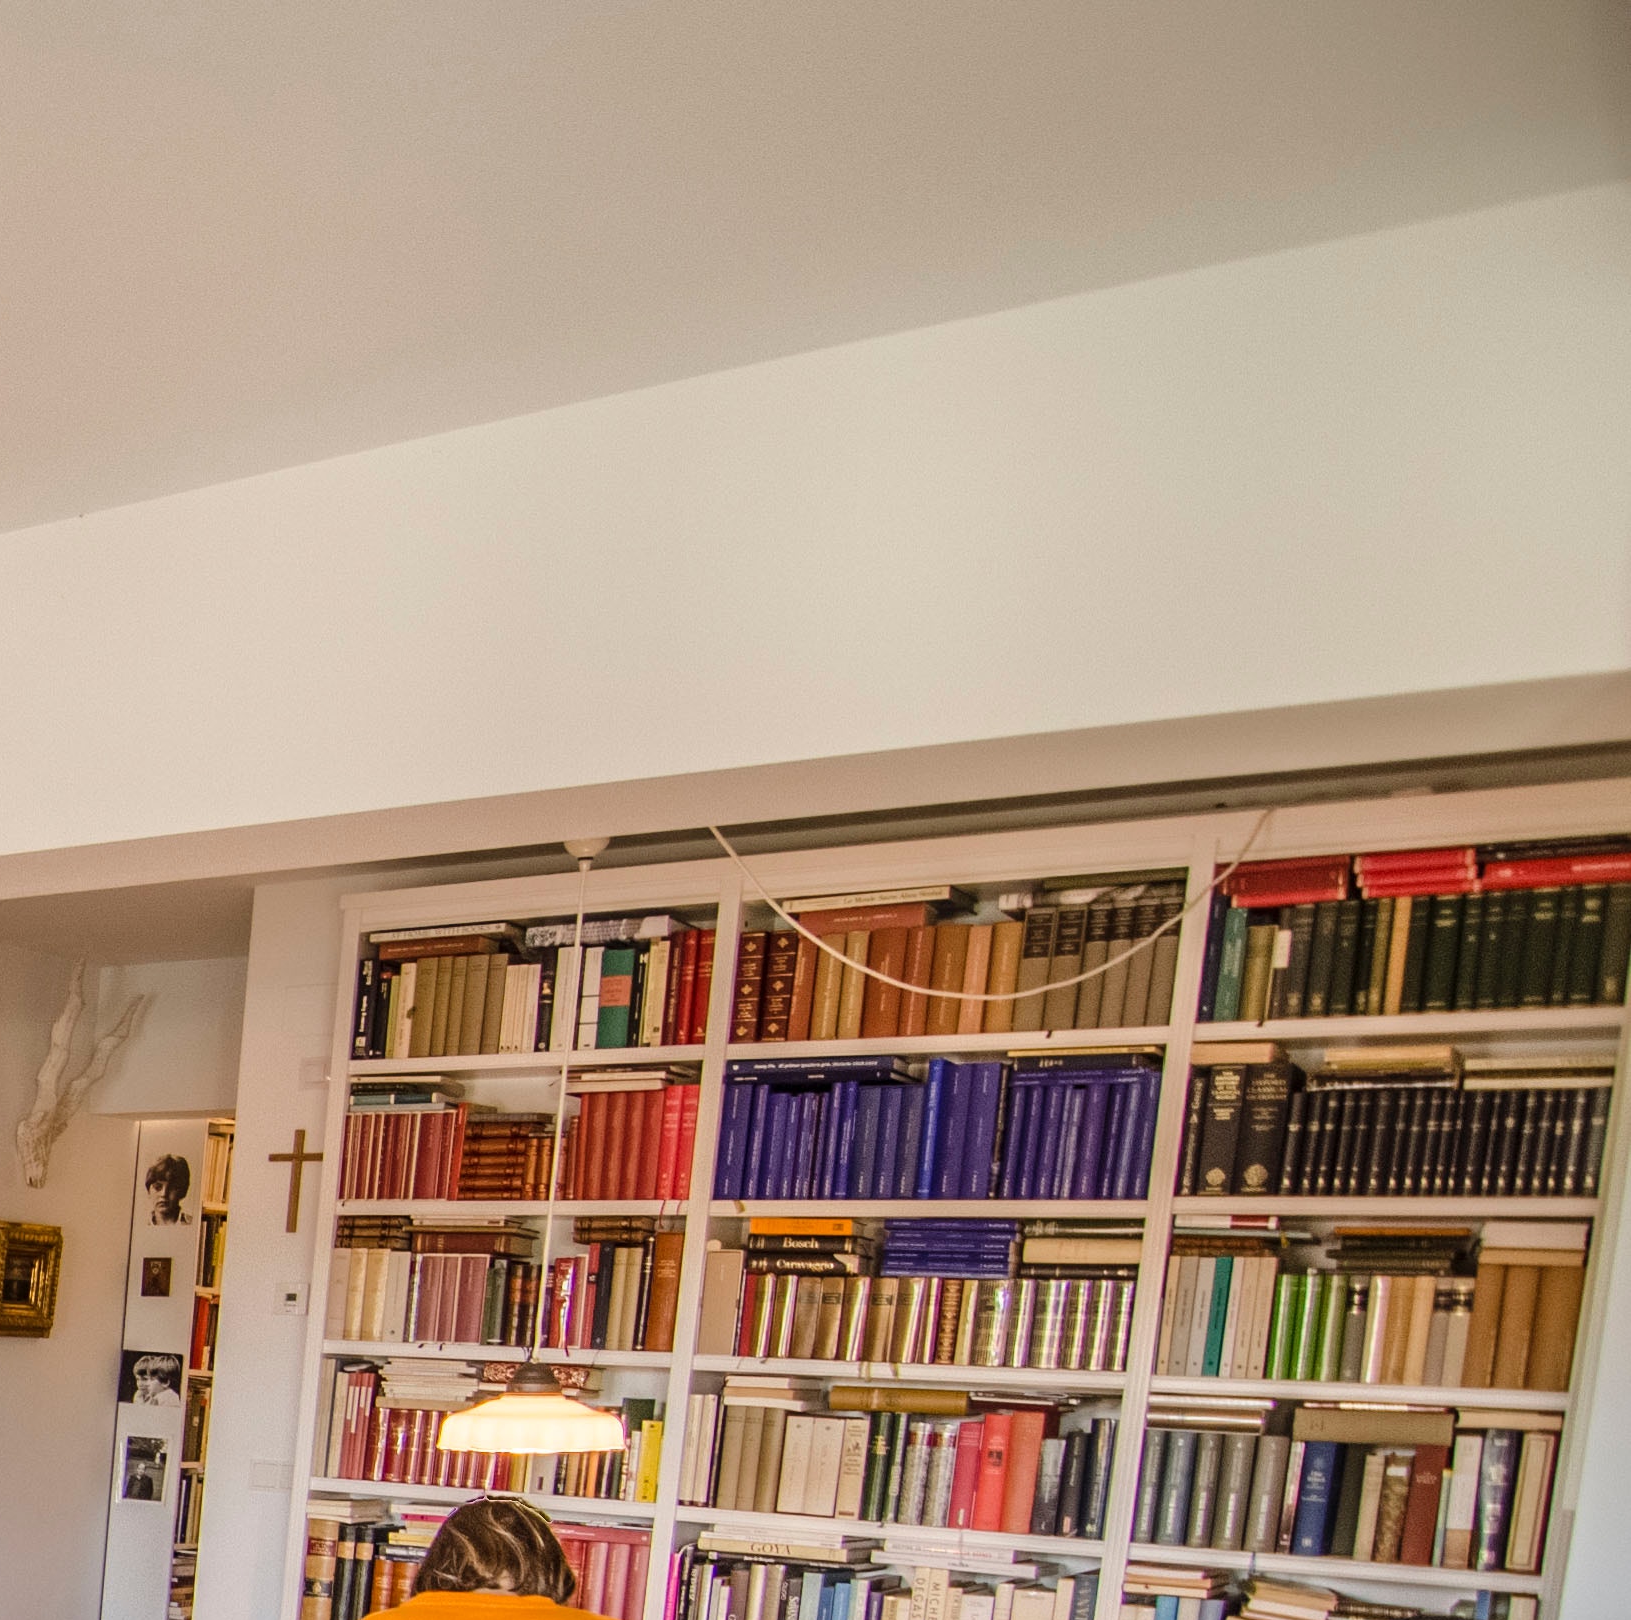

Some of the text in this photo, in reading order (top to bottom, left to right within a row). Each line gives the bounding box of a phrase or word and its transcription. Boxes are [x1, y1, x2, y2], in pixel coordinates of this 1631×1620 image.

[783, 1236, 819, 1249] Bosch
[776, 1258, 835, 1272] Caravaggio
[750, 1542, 791, 1555] GOYA
[911, 1577, 925, 1619] DEGAS
